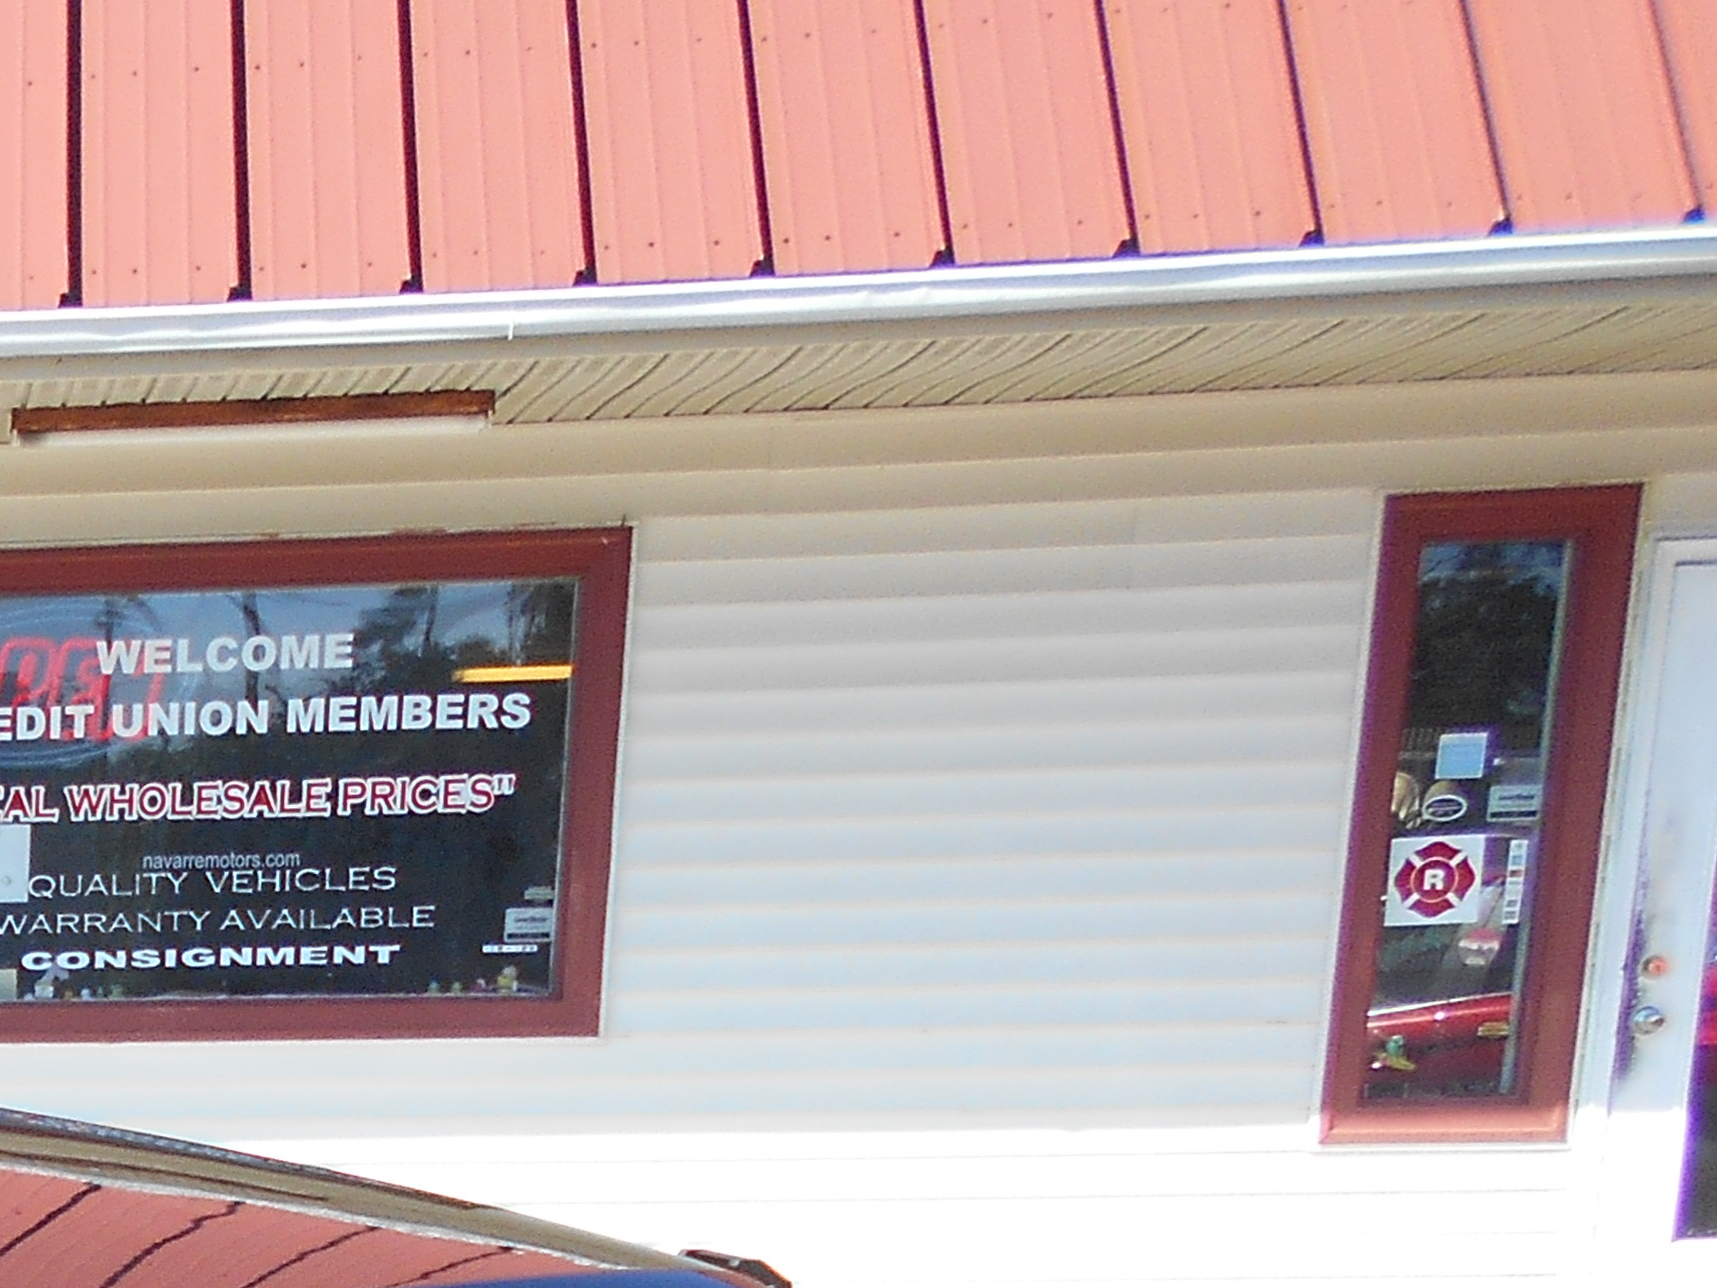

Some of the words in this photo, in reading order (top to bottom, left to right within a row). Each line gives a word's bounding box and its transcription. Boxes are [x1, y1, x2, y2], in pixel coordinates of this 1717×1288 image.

[96, 632, 354, 675] WELCOME
[112, 699, 269, 739] UNION
[286, 692, 532, 734] MEMBERS
[65, 777, 332, 822] WHOLESALE
[337, 773, 516, 816] PRICES"
[142, 851, 301, 870] navarremotors.com
[28, 871, 188, 898] QUALITY
[204, 866, 397, 893] VEHICLES
[1423, 869, 1445, 890] R
[219, 905, 436, 931] AVAILABLE
[21, 944, 401, 970] CONSIGNMENT
